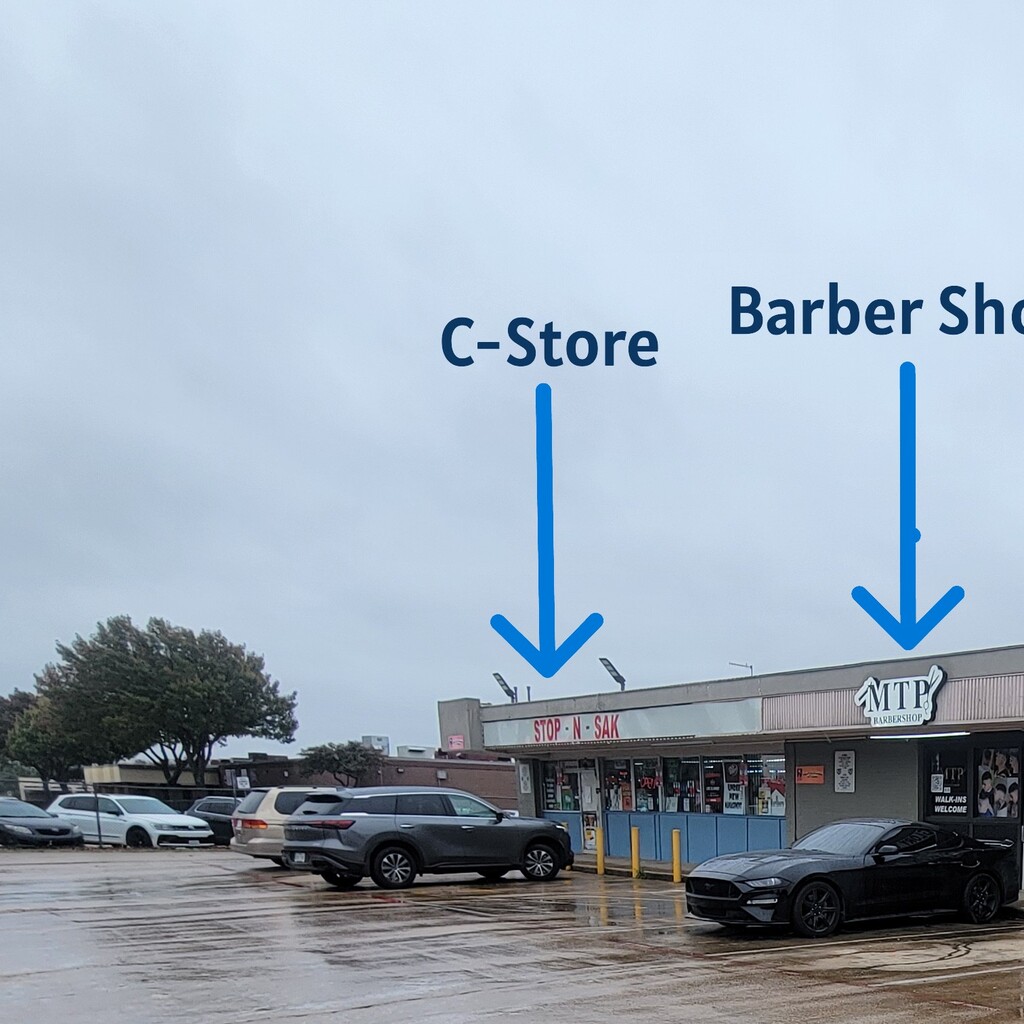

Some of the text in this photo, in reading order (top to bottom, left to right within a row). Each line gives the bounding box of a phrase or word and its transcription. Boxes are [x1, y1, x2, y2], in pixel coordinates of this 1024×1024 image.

[867, 680, 931, 712] MTP
[534, 714, 620, 742] STOP N SAK
[873, 713, 923, 725] BARBERSHOP
[934, 805, 967, 813] WELCOME
